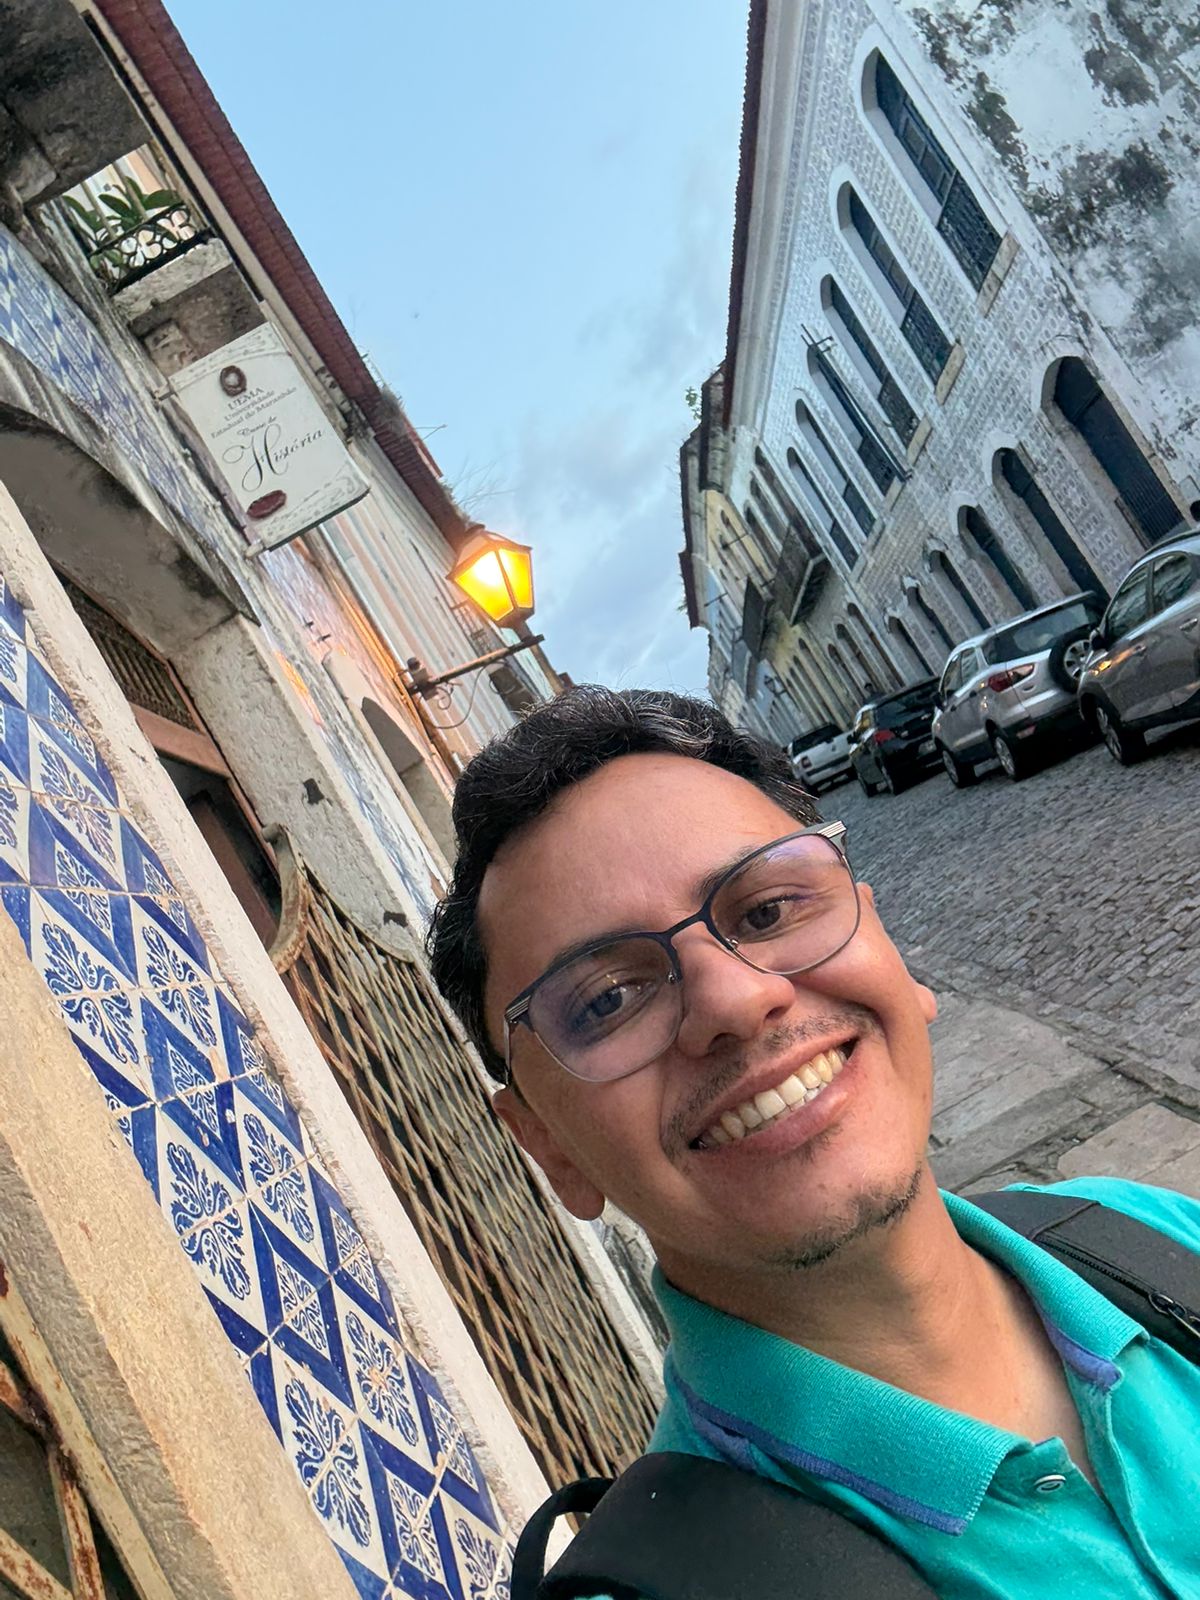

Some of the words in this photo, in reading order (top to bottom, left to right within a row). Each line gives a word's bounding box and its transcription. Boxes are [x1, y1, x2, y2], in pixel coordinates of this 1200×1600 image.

[211, 416, 244, 439] Estadual
[256, 387, 297, 413] Maranhão
[224, 390, 275, 421] Universidade
[228, 387, 264, 410] UEMA
[222, 423, 322, 492] História
